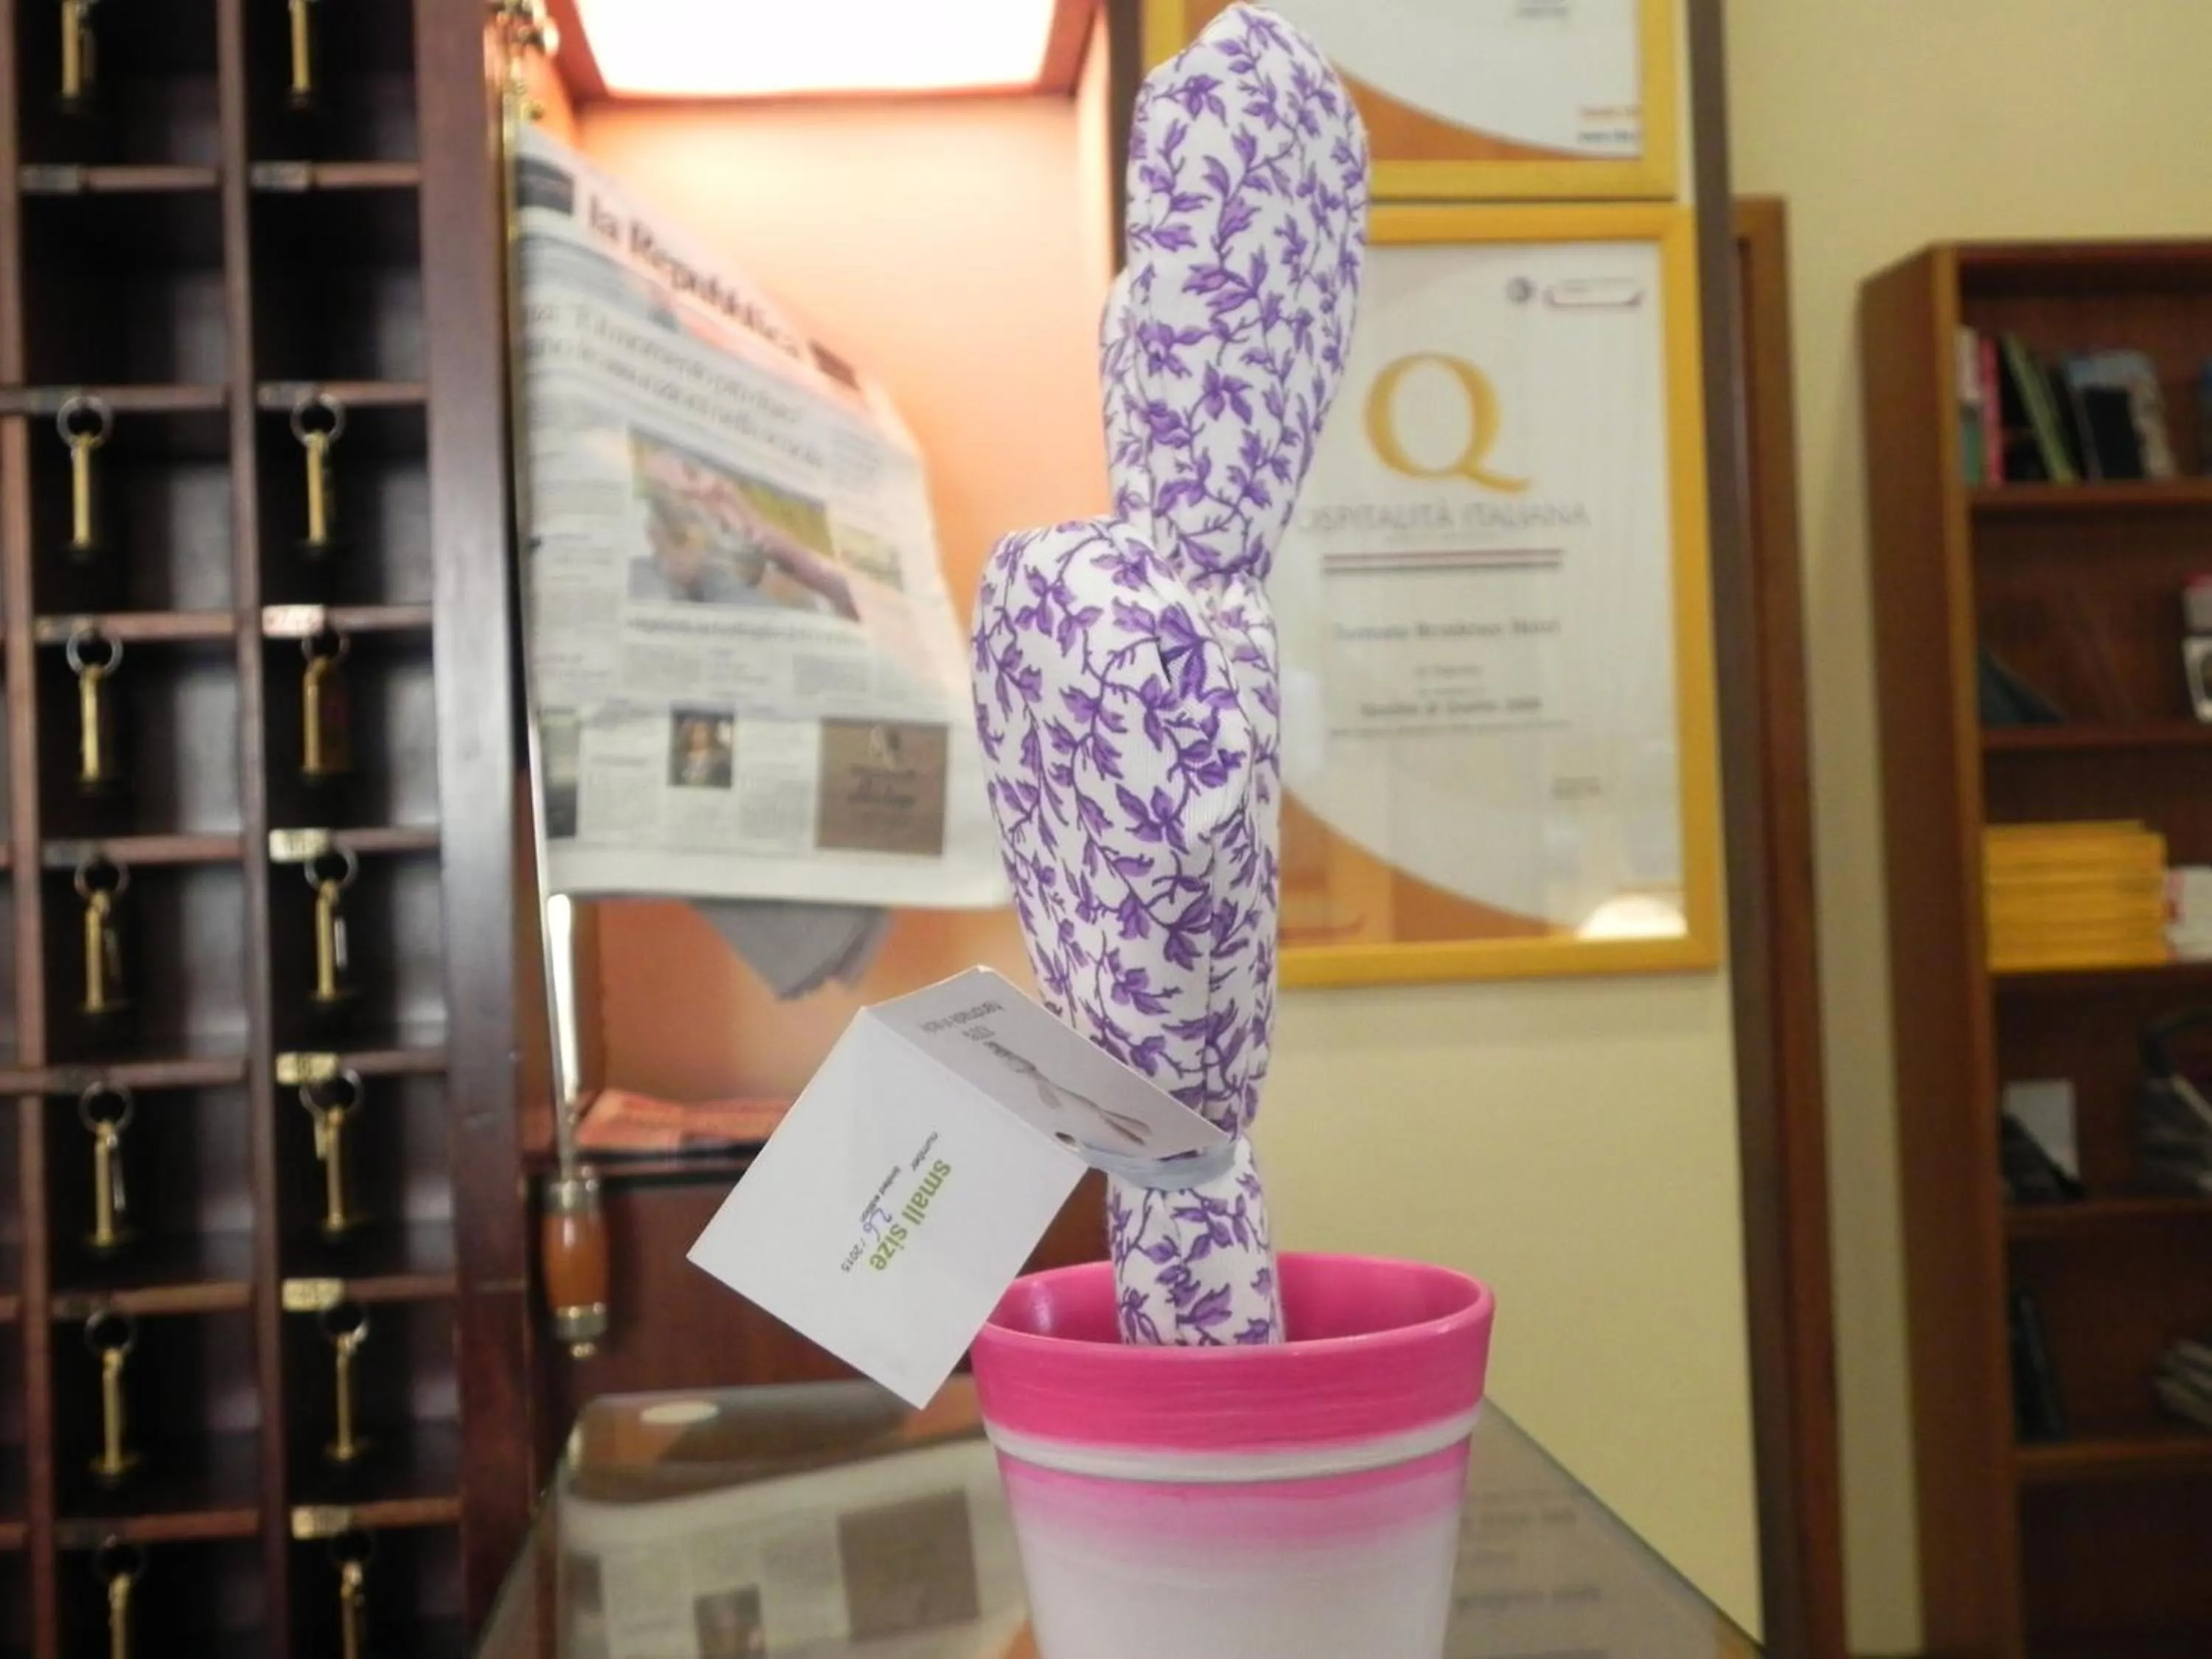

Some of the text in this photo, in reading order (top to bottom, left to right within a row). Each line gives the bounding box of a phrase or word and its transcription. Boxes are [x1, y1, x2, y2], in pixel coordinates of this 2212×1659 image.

[1363, 349, 1531, 494] Q
[869, 1158, 952, 1271] small size
